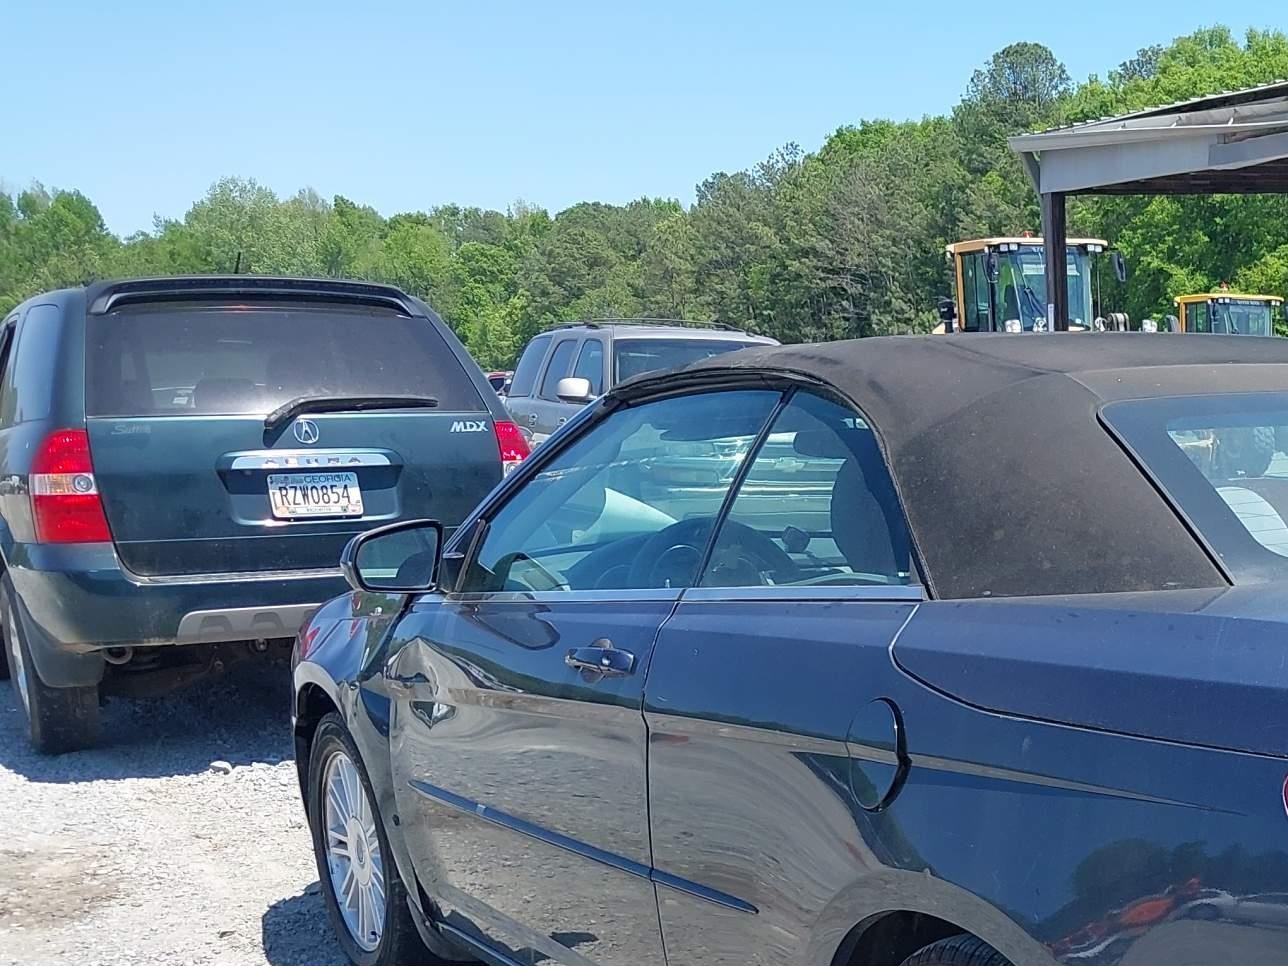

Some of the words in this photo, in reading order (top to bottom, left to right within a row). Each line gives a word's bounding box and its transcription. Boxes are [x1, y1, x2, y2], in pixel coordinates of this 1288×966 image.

[450, 421, 489, 433] MDX
[303, 474, 352, 484] GEORGIA
[278, 484, 351, 506] RZW0854
